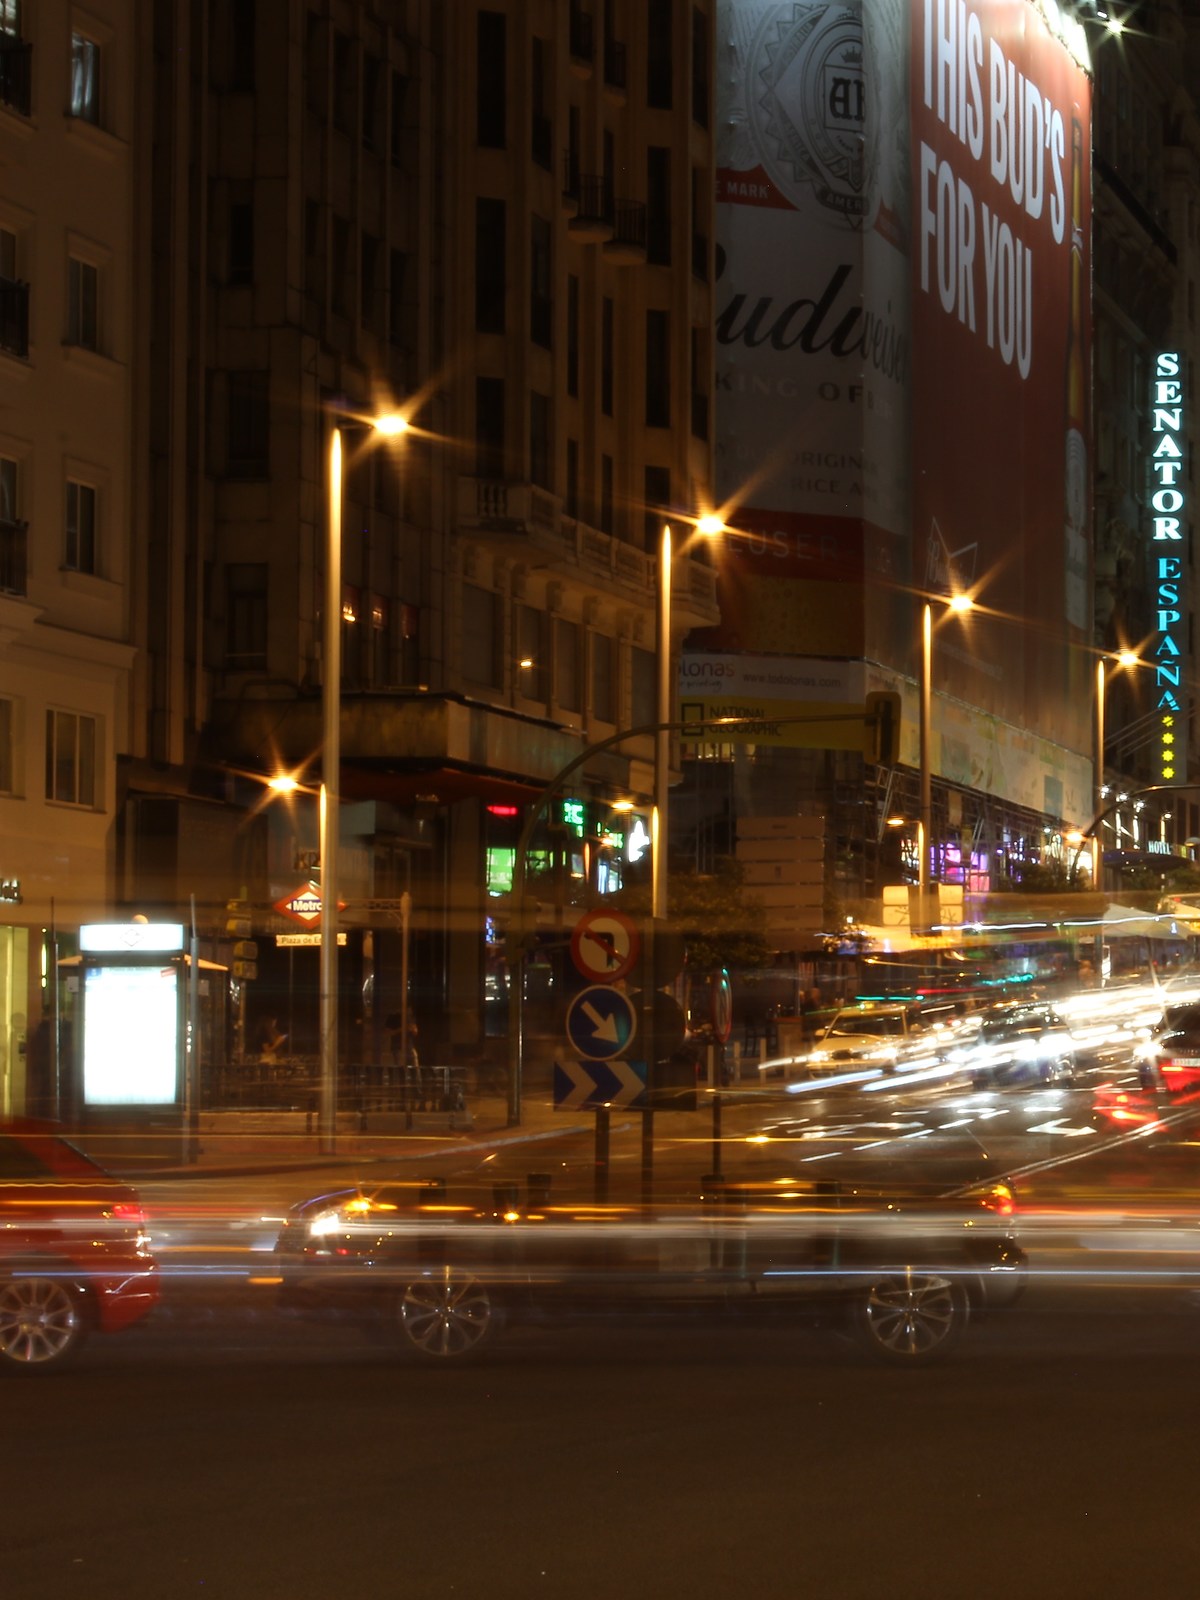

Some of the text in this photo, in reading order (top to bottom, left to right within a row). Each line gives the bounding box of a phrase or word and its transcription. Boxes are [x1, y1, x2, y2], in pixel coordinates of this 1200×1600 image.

[922, 0, 1065, 246] THIS BUD'S
[726, 180, 769, 200] MARK
[920, 140, 1032, 381] FOR YOU
[818, 382, 864, 404] OF
[1151, 352, 1183, 712] SENATOR ESPAÑA
[743, 672, 841, 688] www.todolonas.com
[708, 721, 782, 737] GEOGRAPHIC
[1148, 840, 1171, 856] HOTEL
[281, 936, 301, 944] Plaza
